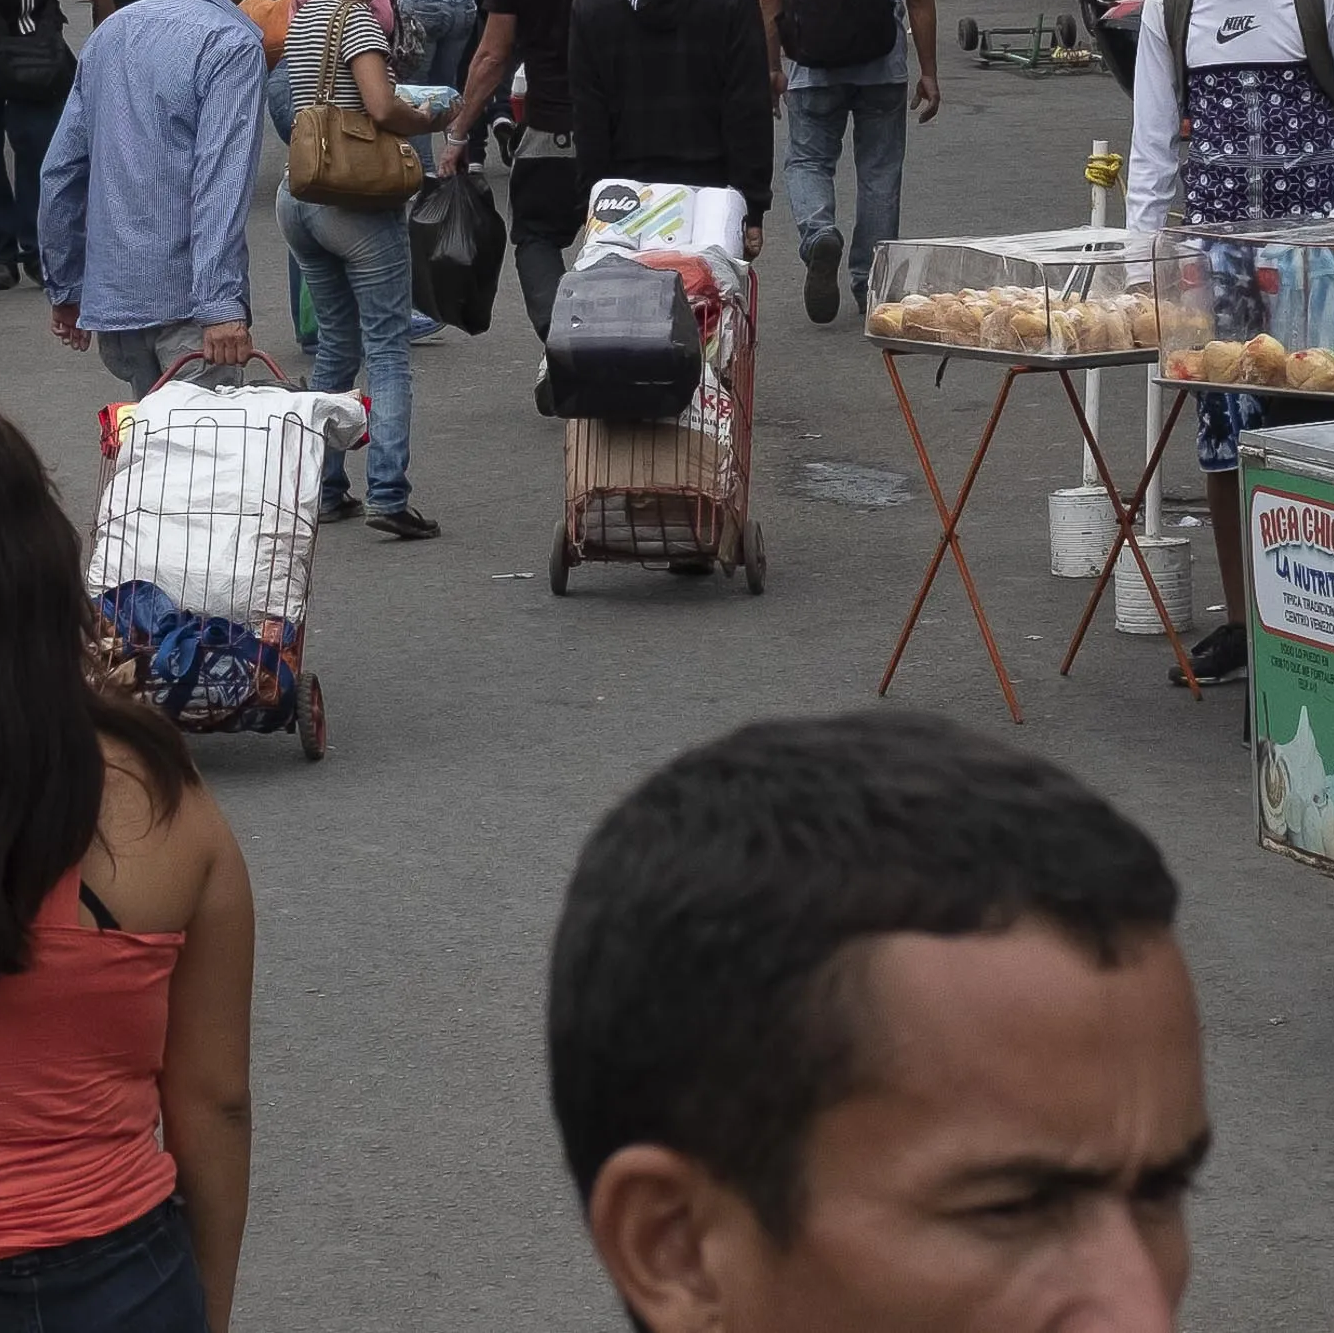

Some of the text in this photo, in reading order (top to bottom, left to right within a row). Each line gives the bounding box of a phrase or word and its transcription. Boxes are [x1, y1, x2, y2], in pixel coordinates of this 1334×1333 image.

[1222, 16, 1256, 31] NIKE
[1259, 505, 1300, 549] RICA
[1274, 550, 1291, 584] LA
